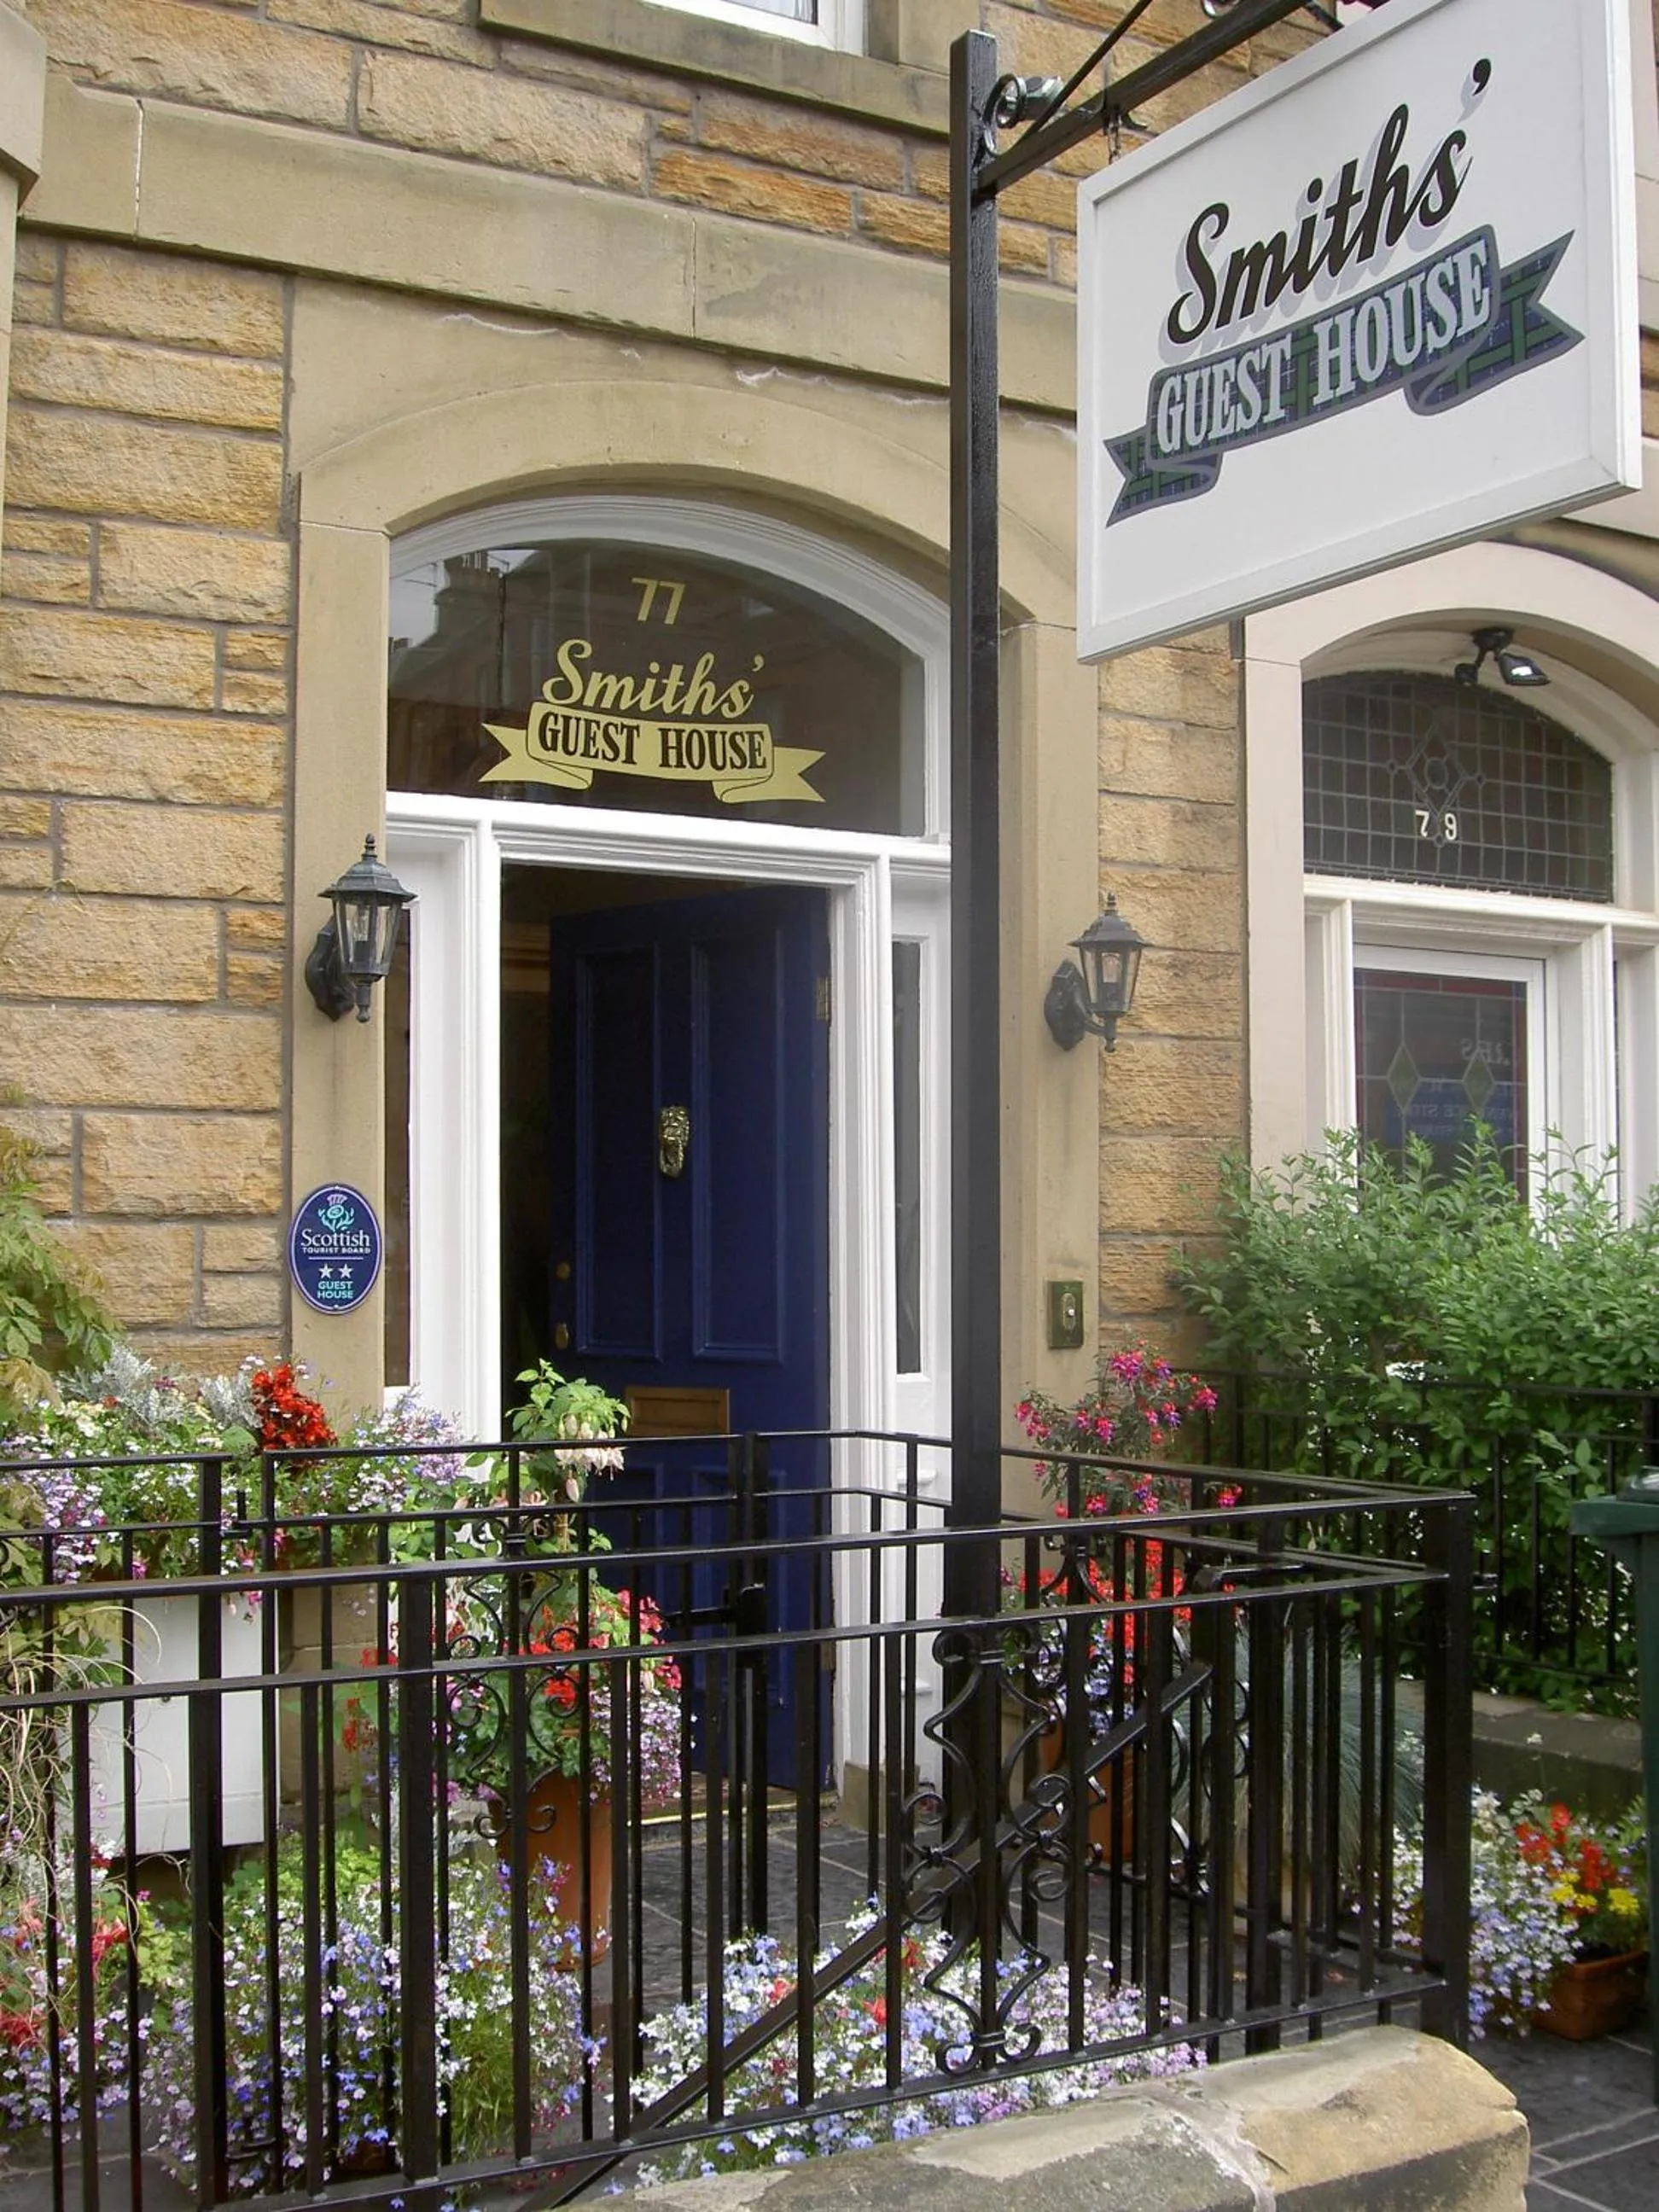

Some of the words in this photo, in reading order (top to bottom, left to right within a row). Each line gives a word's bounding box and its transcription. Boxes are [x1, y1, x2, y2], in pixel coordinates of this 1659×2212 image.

[1167, 57, 1493, 345] Smiths'
[1155, 331, 1295, 455] GUEST
[1313, 238, 1491, 407] HOUSE
[632, 576, 686, 626] 77
[541, 637, 765, 719] Smiths'
[538, 710, 640, 766] GUEST
[658, 727, 768, 771] HOUSE
[1415, 809, 1458, 841] 79
[300, 1228, 370, 1248] Scottish
[317, 1280, 353, 1289] GUEST
[317, 1289, 354, 1299] HOUSE
